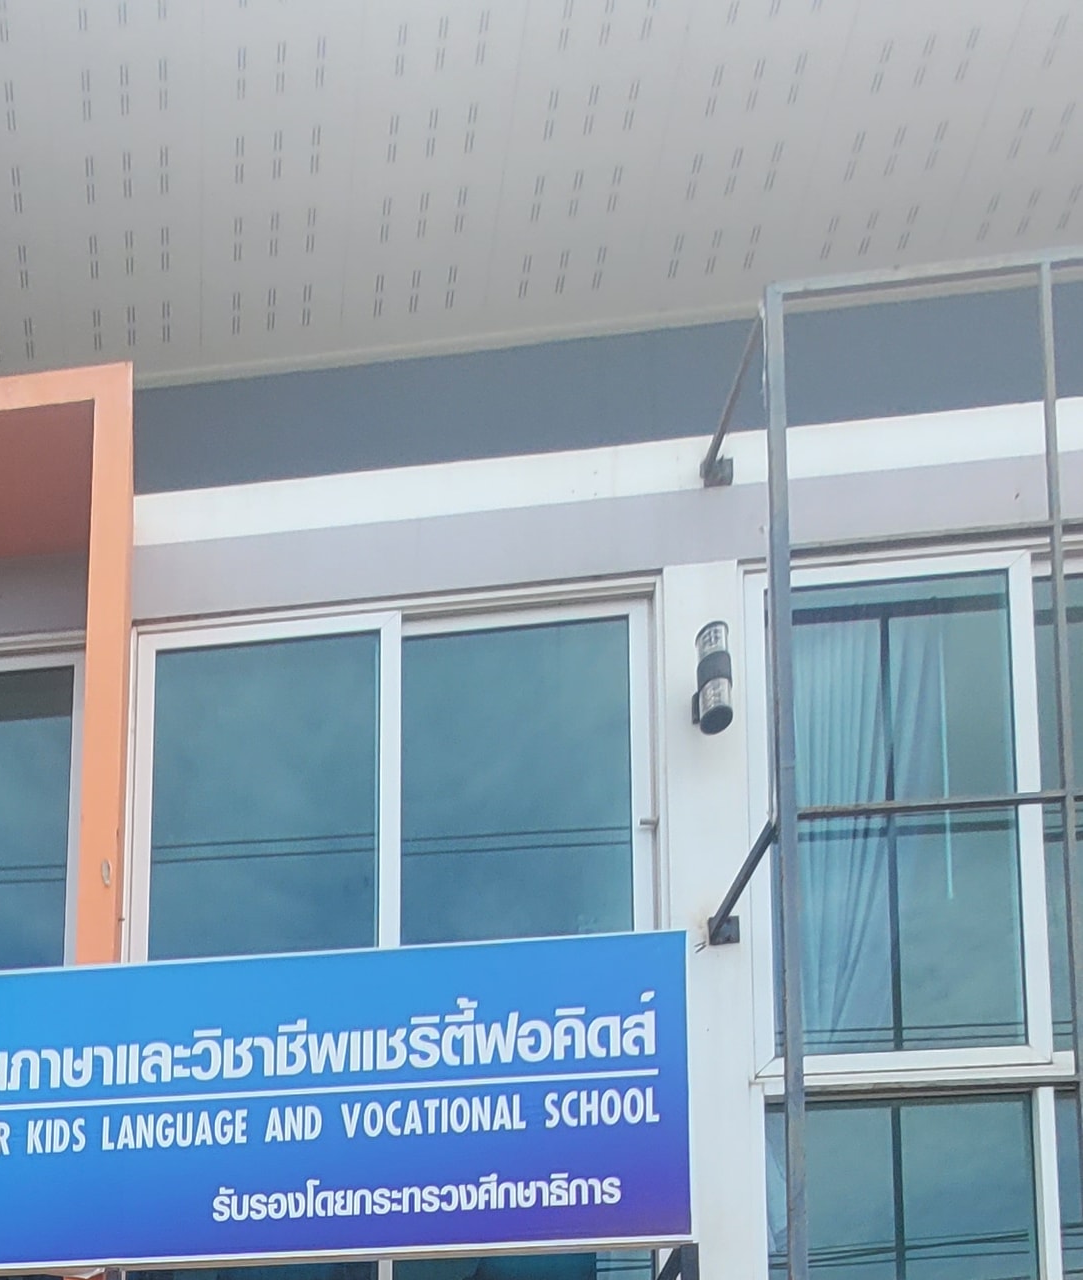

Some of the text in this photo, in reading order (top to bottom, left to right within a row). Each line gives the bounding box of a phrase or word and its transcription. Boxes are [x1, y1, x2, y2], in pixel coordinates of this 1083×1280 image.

[26, 1117, 86, 1155] KIDS
[101, 1108, 248, 1151] LANGUAGE
[264, 1105, 323, 1143] AND
[340, 1094, 527, 1139] VOCATIONAL
[544, 1086, 660, 1129] SCHOOL
[212, 1172, 622, 1222] รับรองโดยกระทรวงศึกษาธิการ
